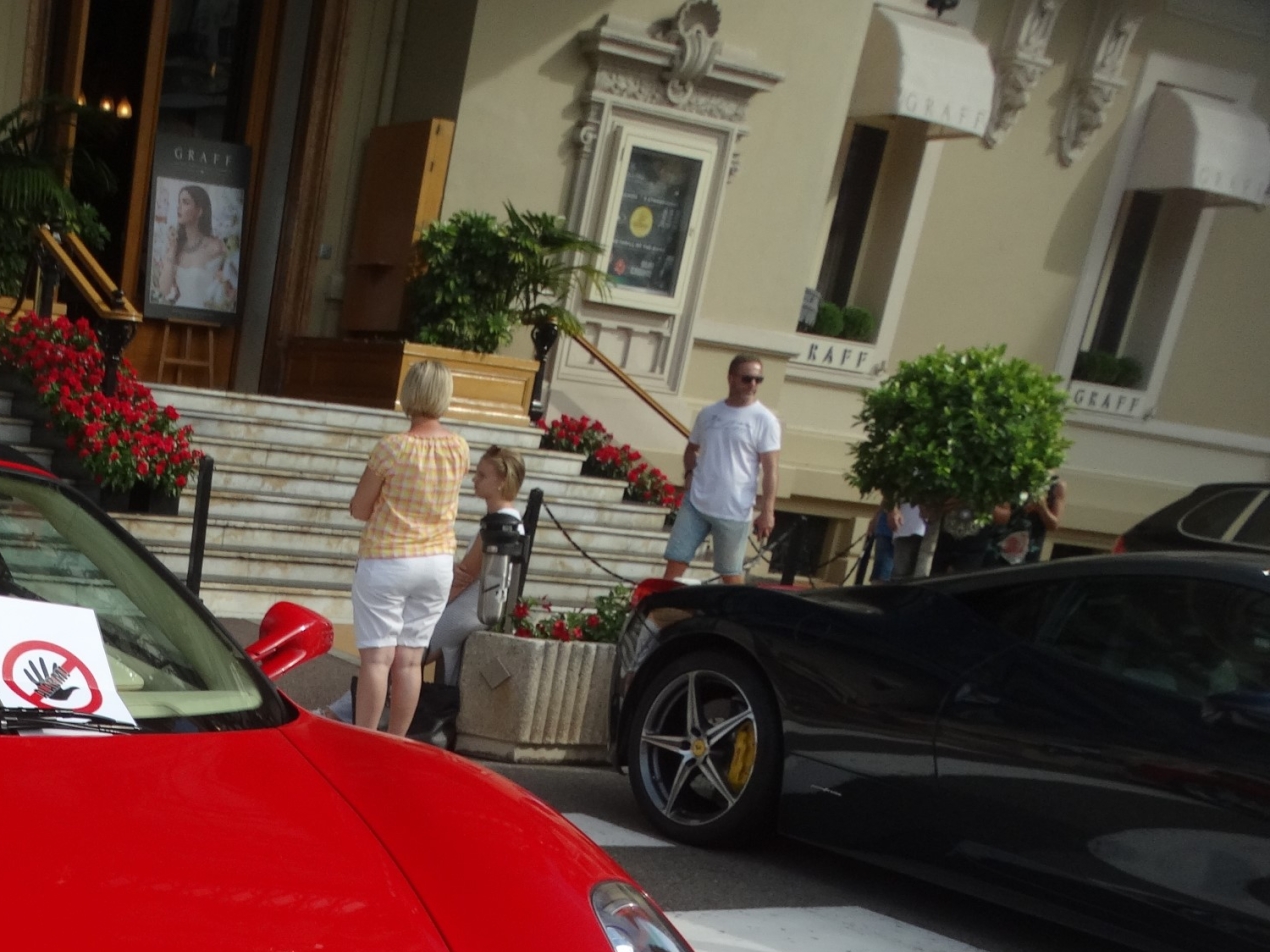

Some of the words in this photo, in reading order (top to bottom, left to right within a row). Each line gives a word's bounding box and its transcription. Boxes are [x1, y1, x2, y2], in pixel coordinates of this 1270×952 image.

[174, 147, 232, 167] GRAFF
[807, 343, 868, 369] RAFF
[1073, 388, 1140, 412] GRAFF
